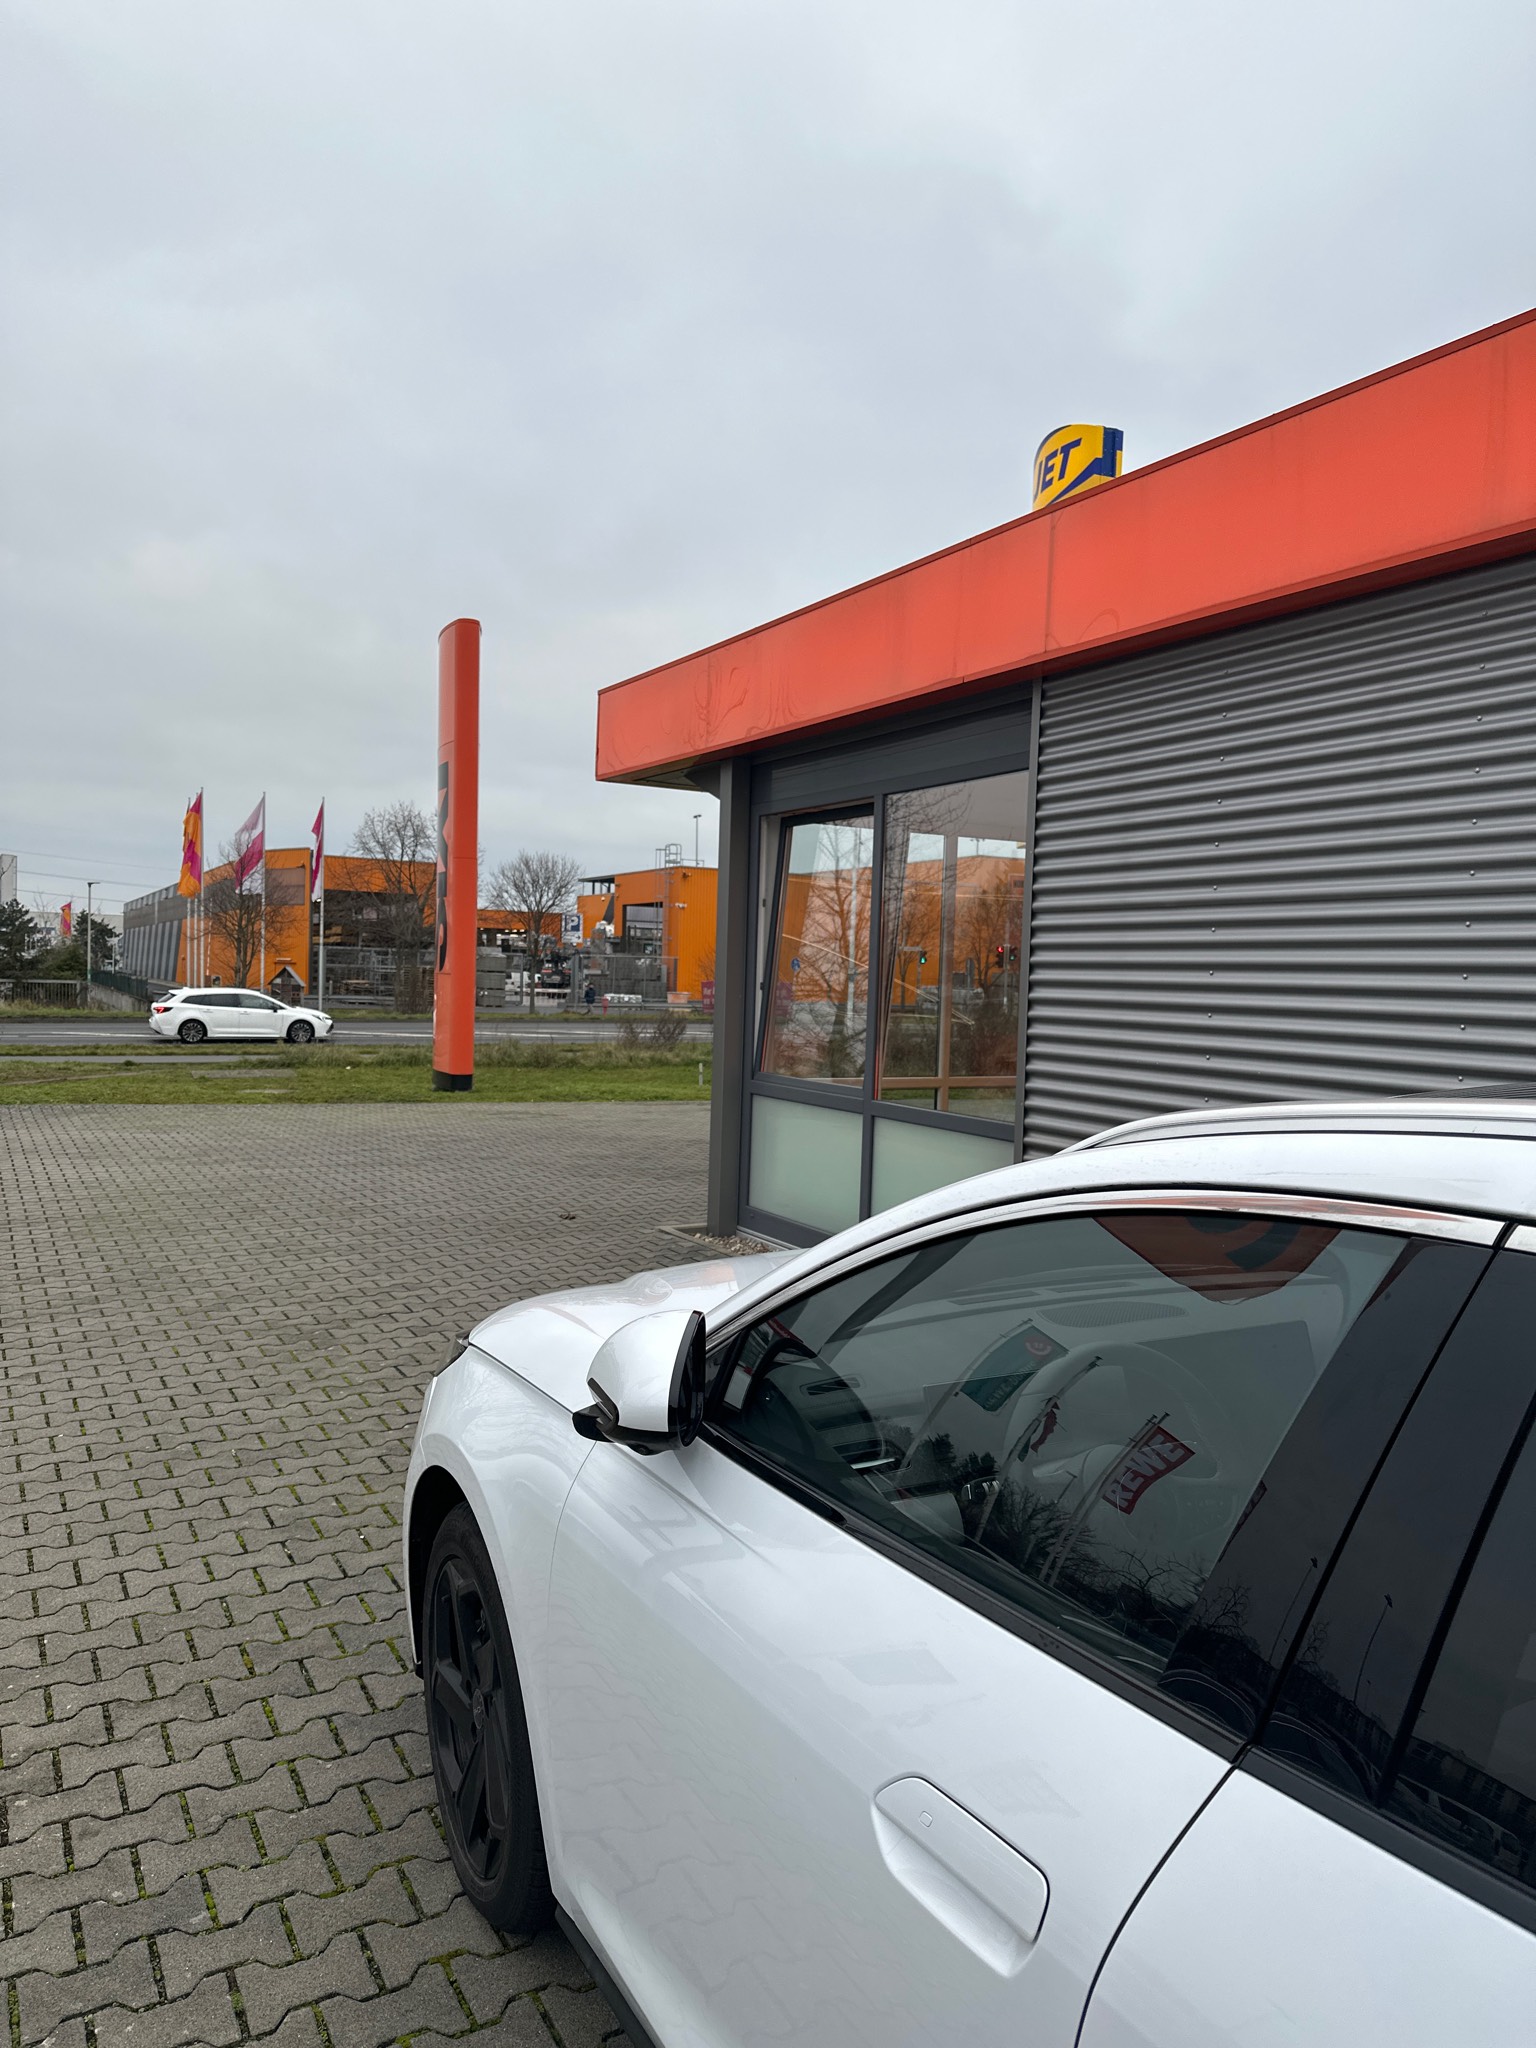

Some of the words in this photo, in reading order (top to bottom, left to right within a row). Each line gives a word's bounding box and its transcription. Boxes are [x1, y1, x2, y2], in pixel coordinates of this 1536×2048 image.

[1033, 437, 1083, 503] JET
[566, 915, 579, 931] P
[1108, 1434, 1186, 1509] REWE
